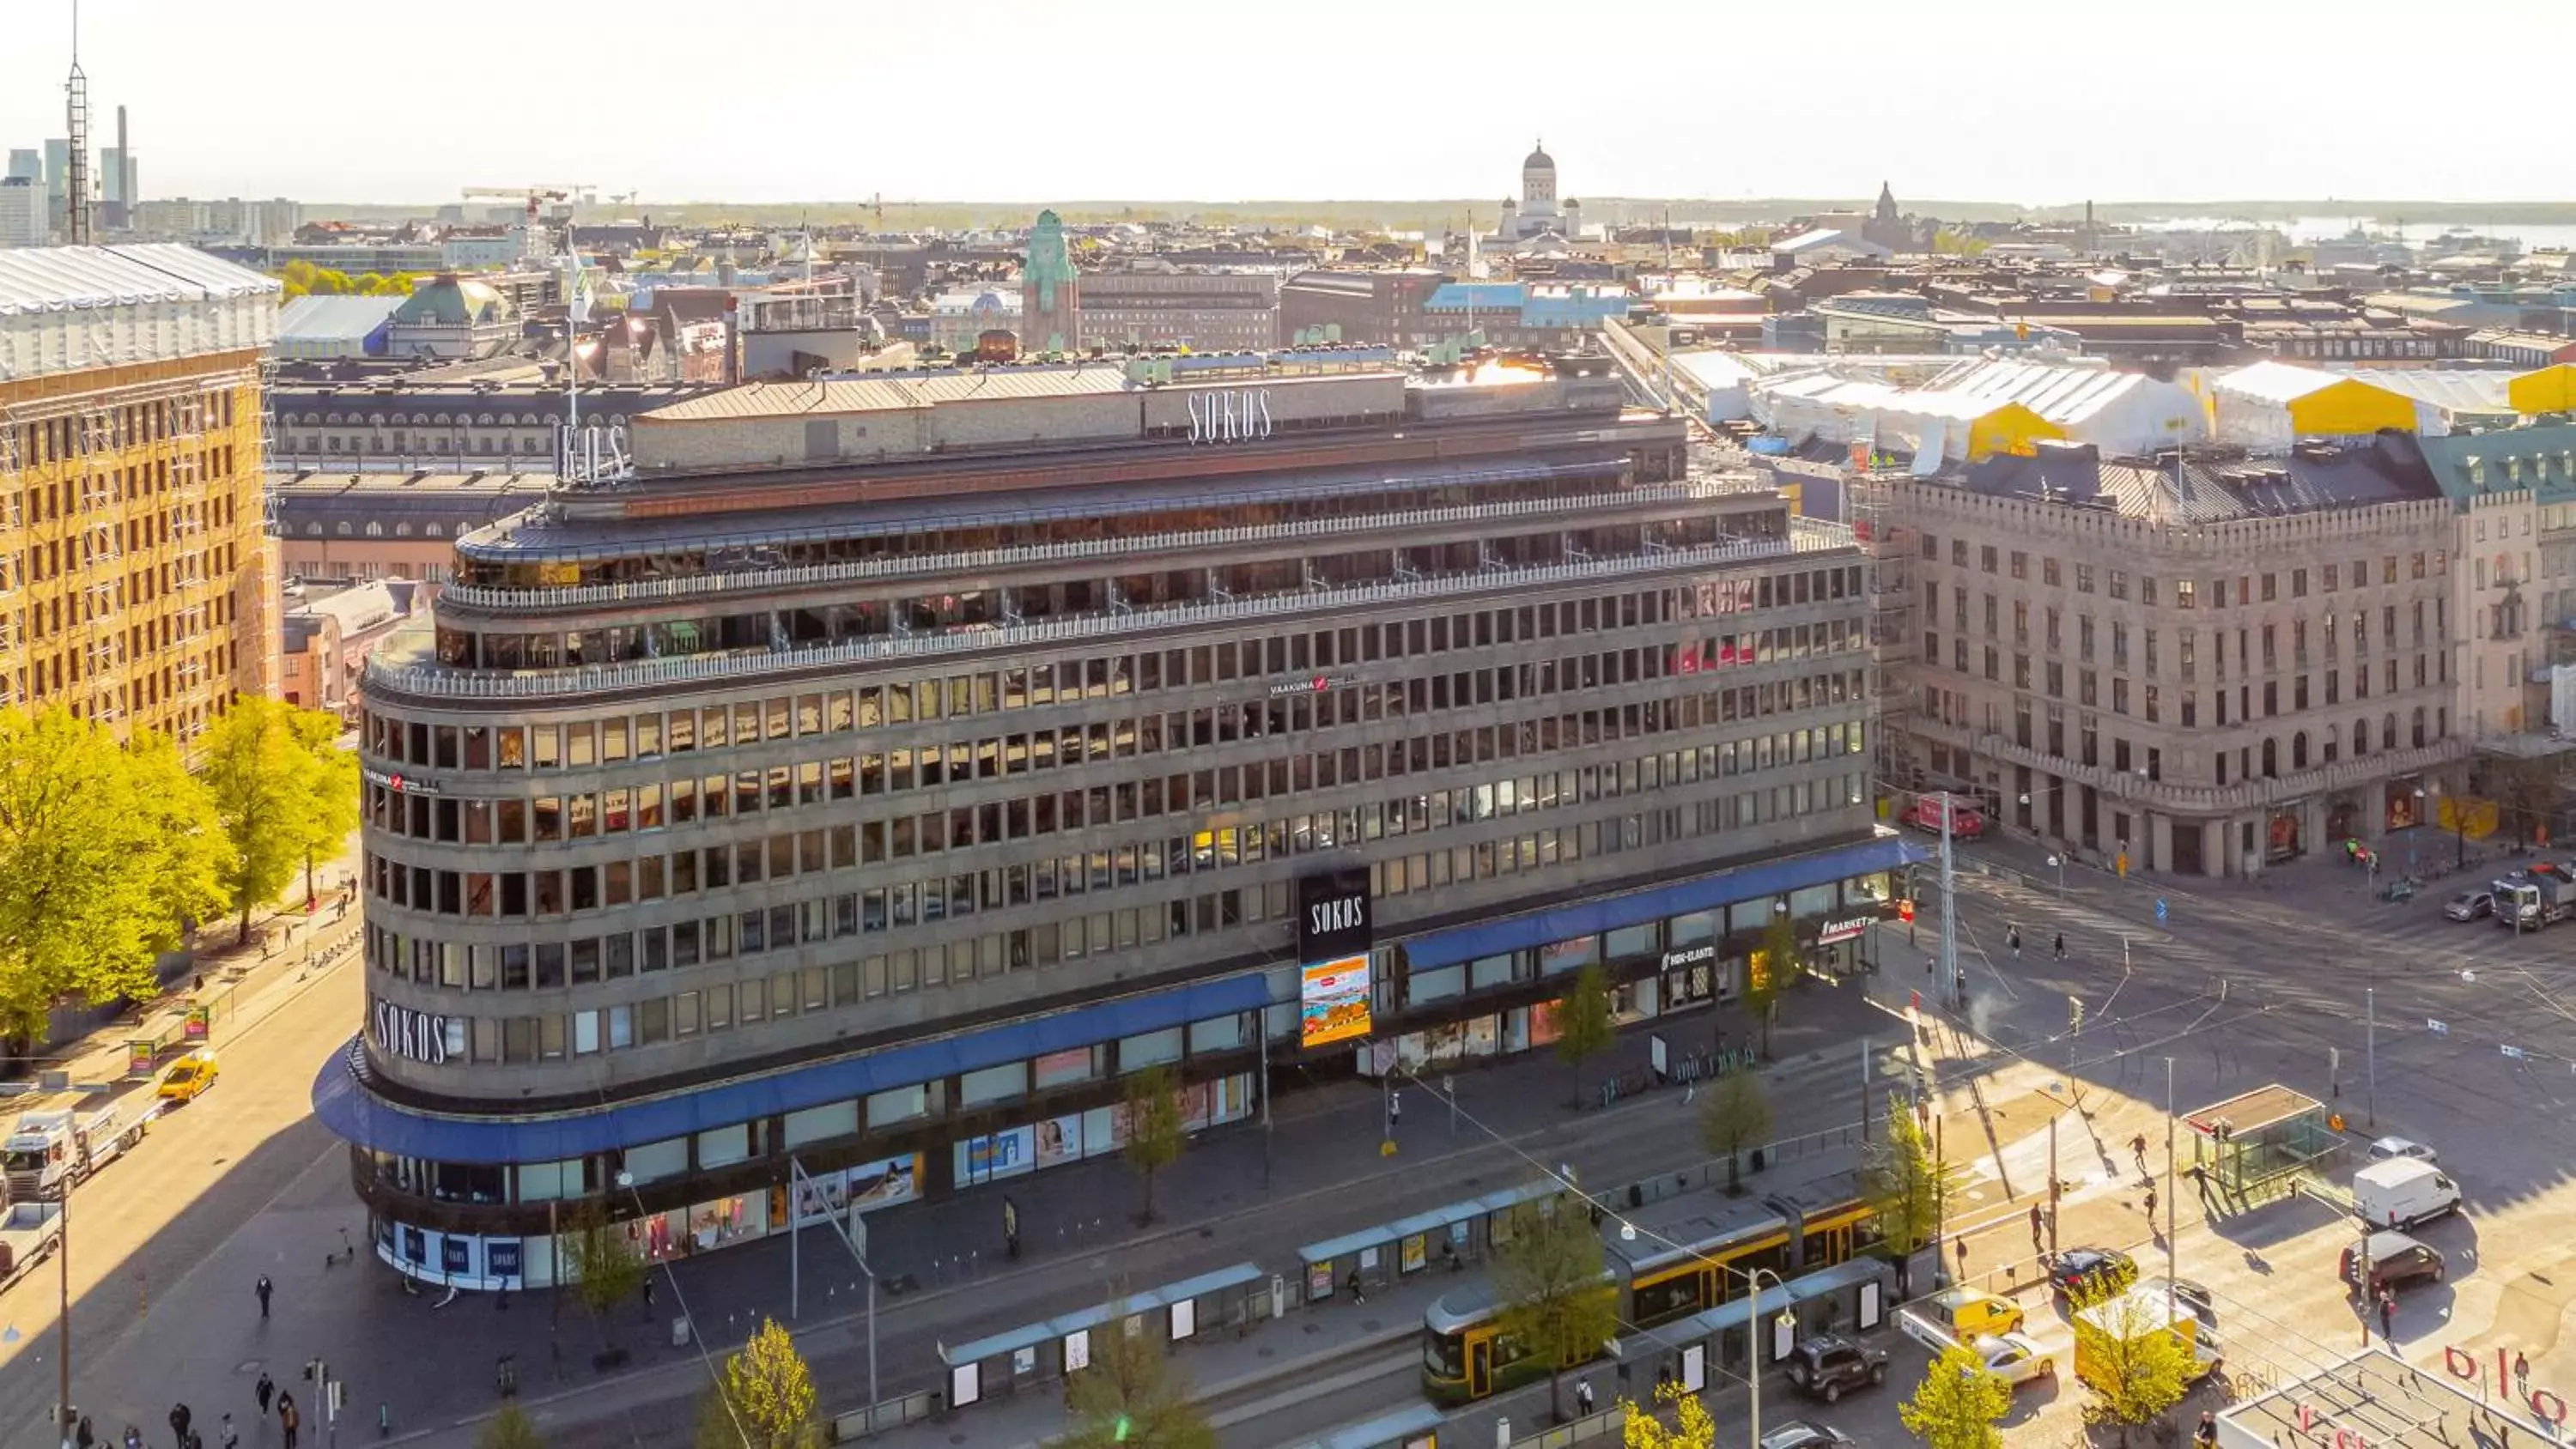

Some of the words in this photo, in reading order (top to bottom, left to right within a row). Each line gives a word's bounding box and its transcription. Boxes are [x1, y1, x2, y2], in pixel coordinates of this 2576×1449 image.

[1188, 388, 1271, 441] SOKOS
[1311, 895, 1363, 934] SOKOS
[378, 1000, 445, 1064] SOKOS
